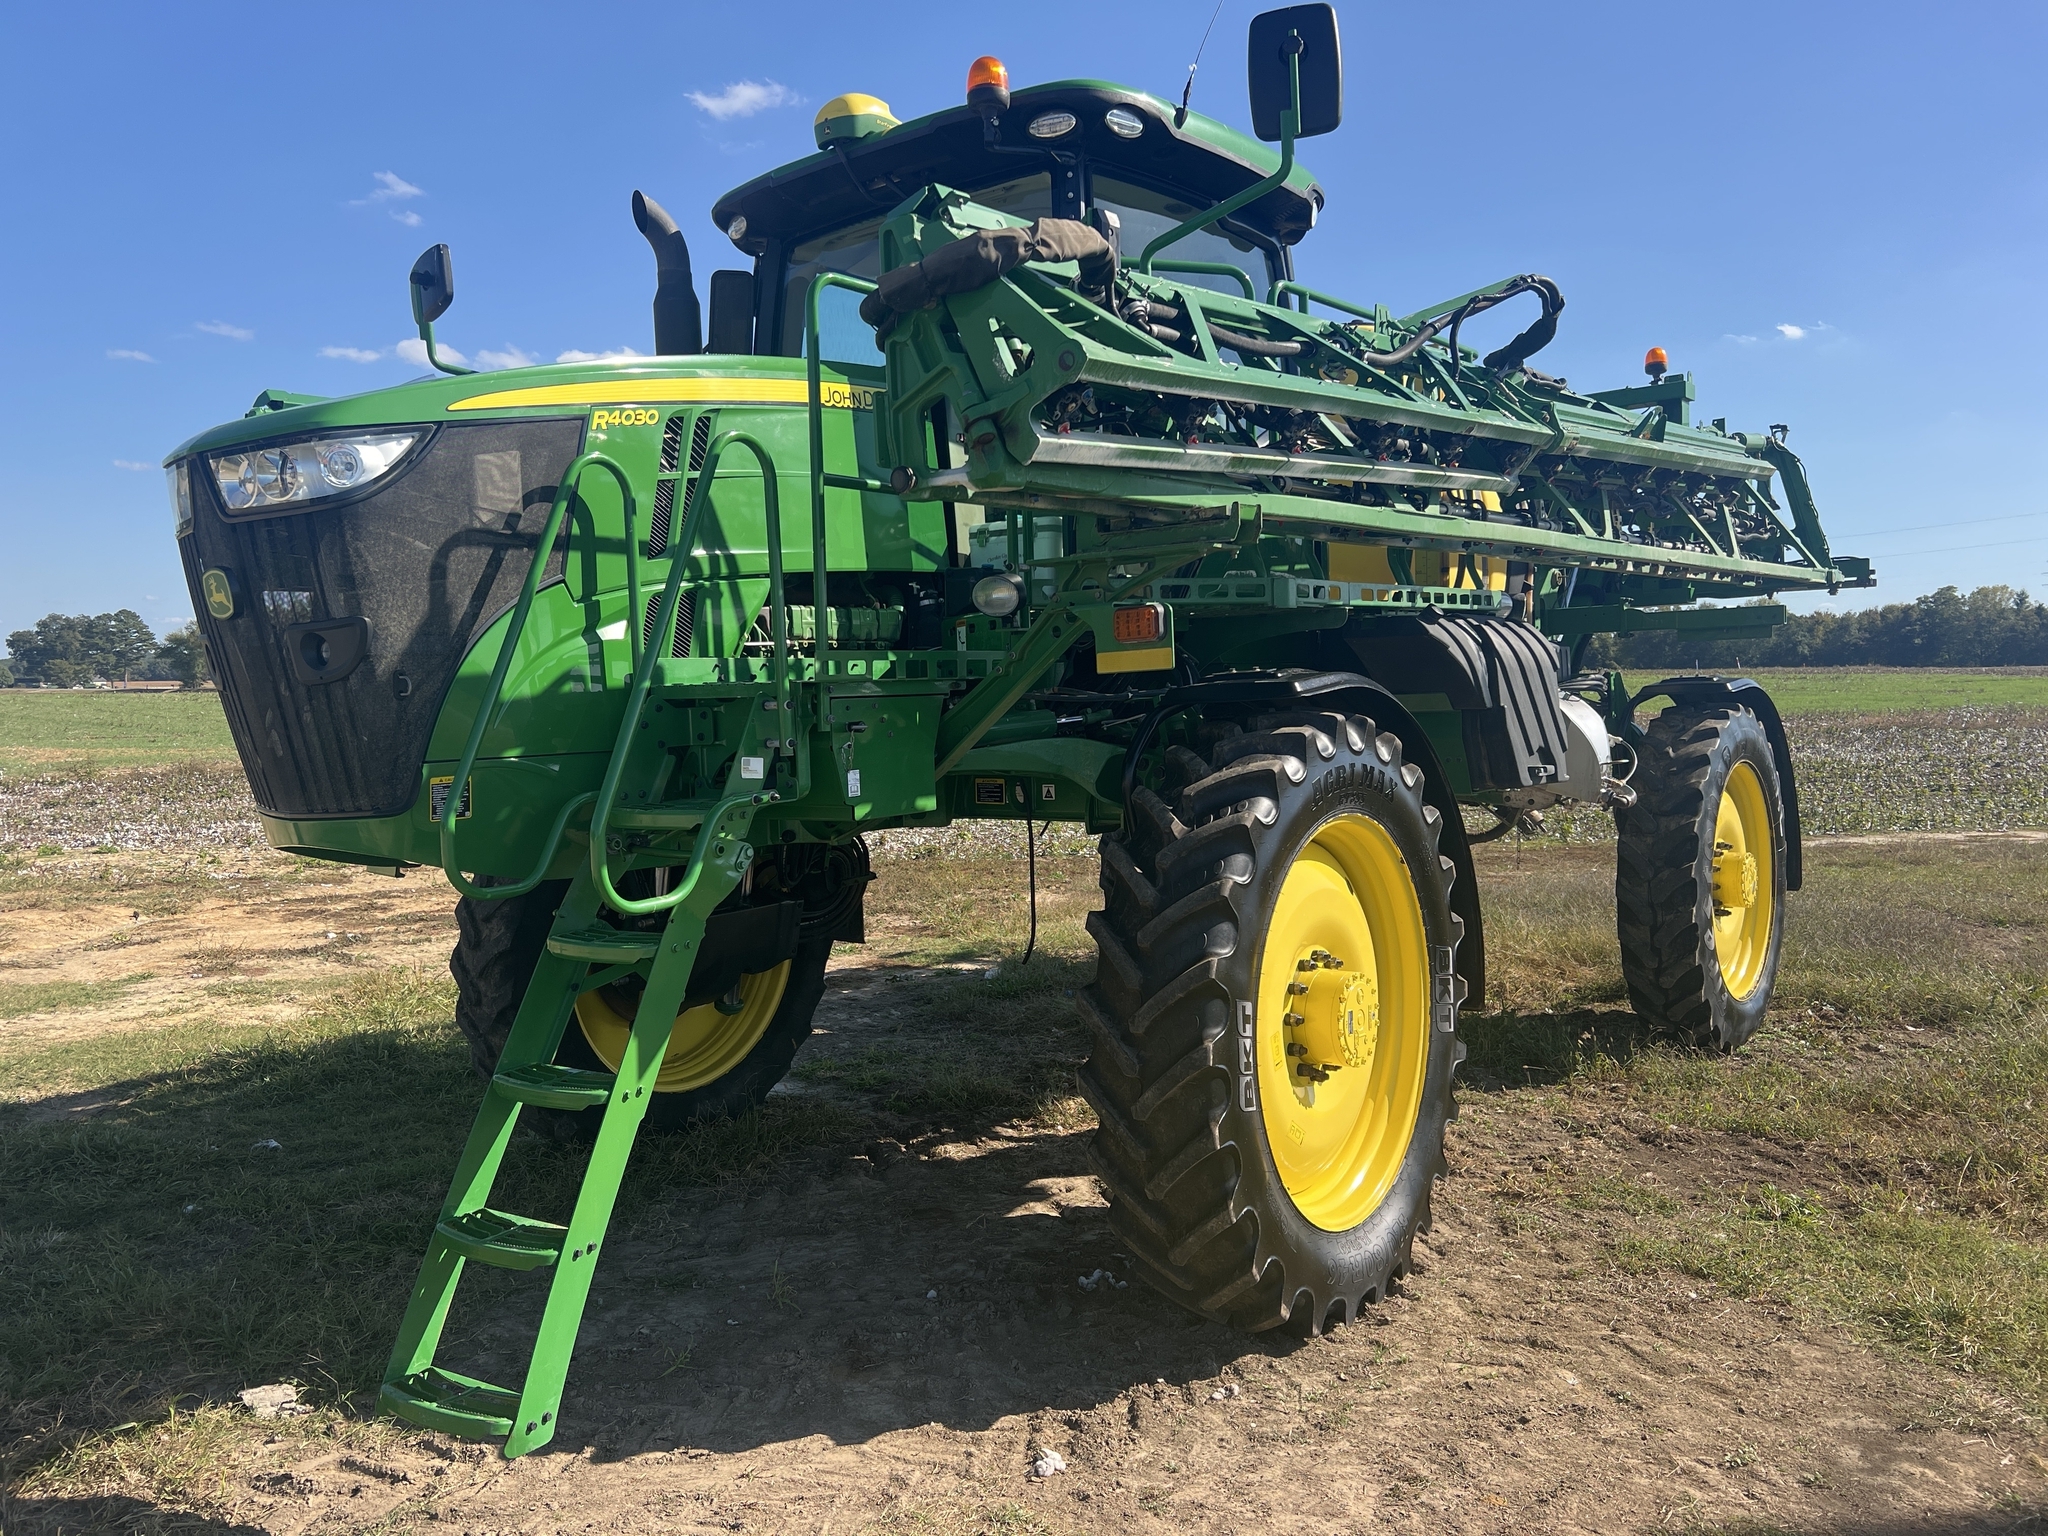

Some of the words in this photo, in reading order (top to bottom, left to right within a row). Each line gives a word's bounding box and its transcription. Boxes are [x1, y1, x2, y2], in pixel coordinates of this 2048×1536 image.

[591, 409, 660, 430] R4030
[824, 386, 862, 406] JOHN
[1435, 945, 1454, 1033] BKT
[1236, 999, 1256, 1112] BKT
